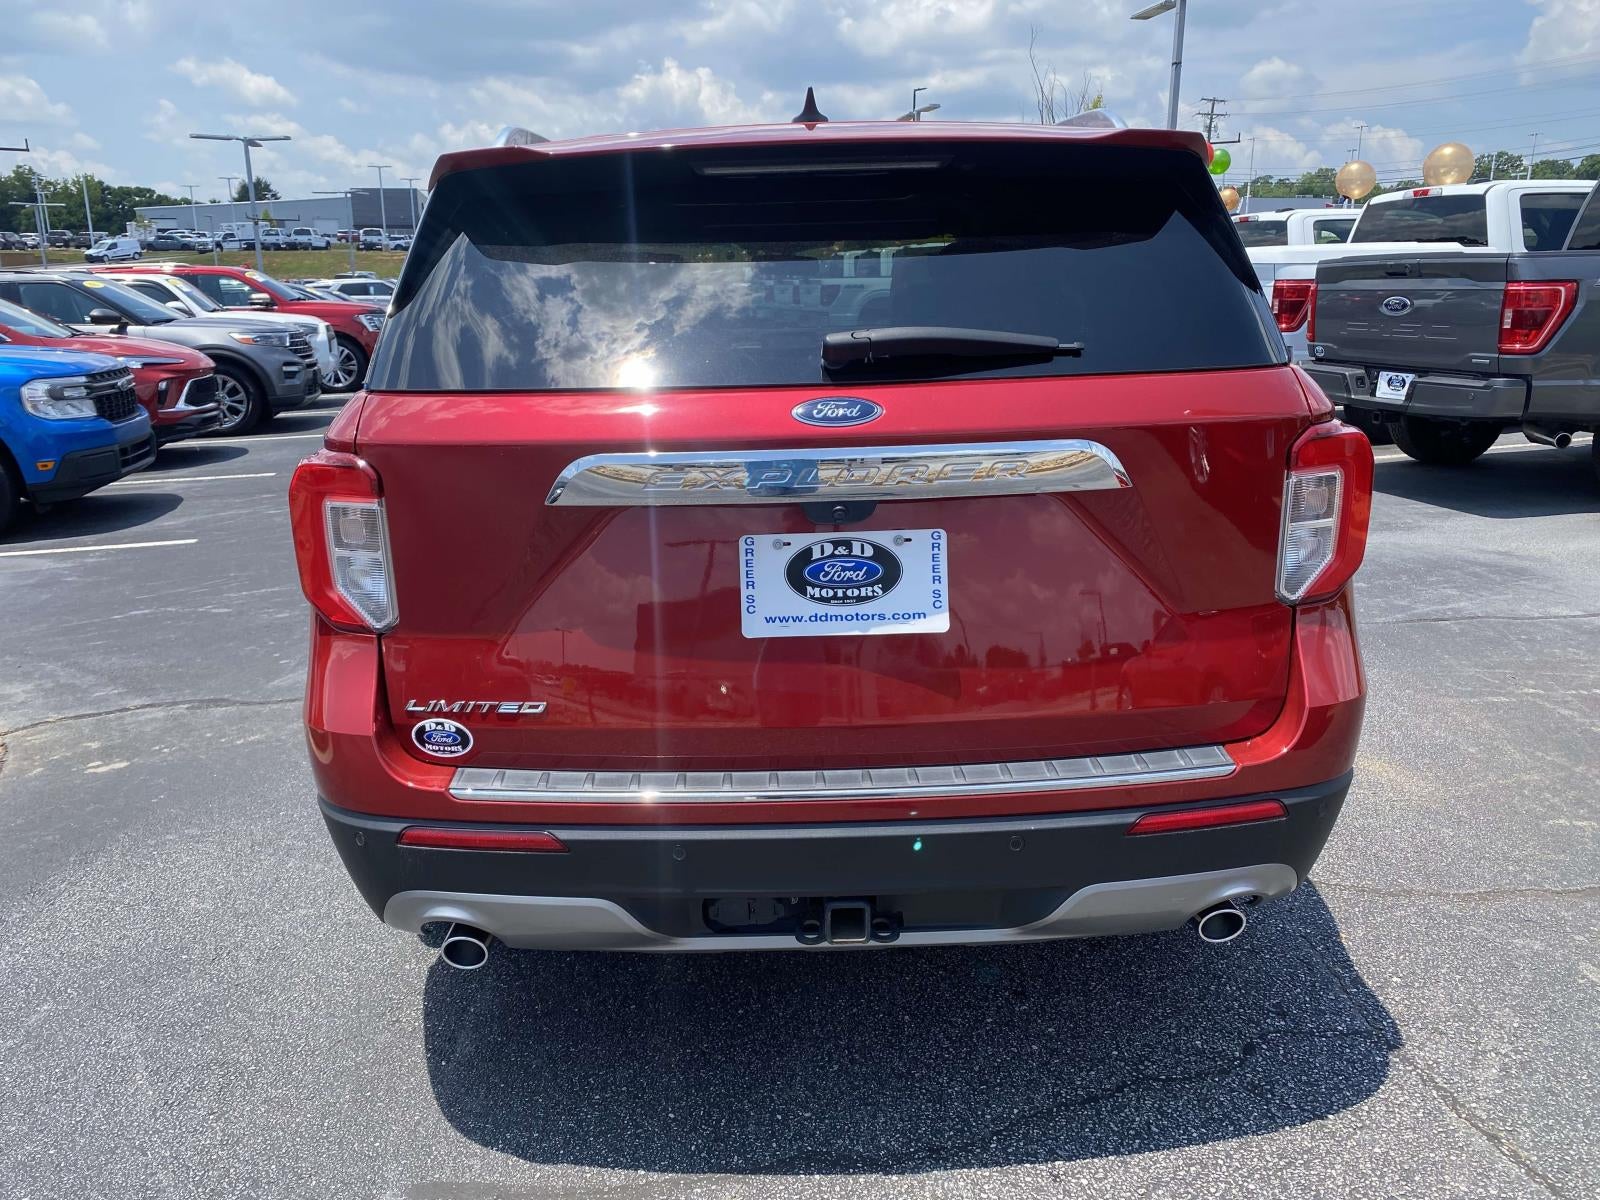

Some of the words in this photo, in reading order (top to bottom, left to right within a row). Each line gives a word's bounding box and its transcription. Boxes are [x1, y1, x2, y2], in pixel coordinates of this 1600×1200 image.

[813, 401, 861, 418] Ford
[641, 459, 1031, 490] EXPLORER
[811, 541, 874, 560] D&D
[931, 530, 941, 585] GREER
[744, 536, 755, 590] GREER
[820, 562, 867, 581] Ford
[806, 584, 883, 598] MOTORS
[932, 589, 943, 609] SC
[746, 594, 756, 615] SC
[764, 610, 927, 624] www.ddmotors.com
[405, 699, 547, 714] LIMITED
[425, 722, 456, 732] D&D
[430, 733, 454, 743] Ford
[425, 744, 462, 752] MOTORS
